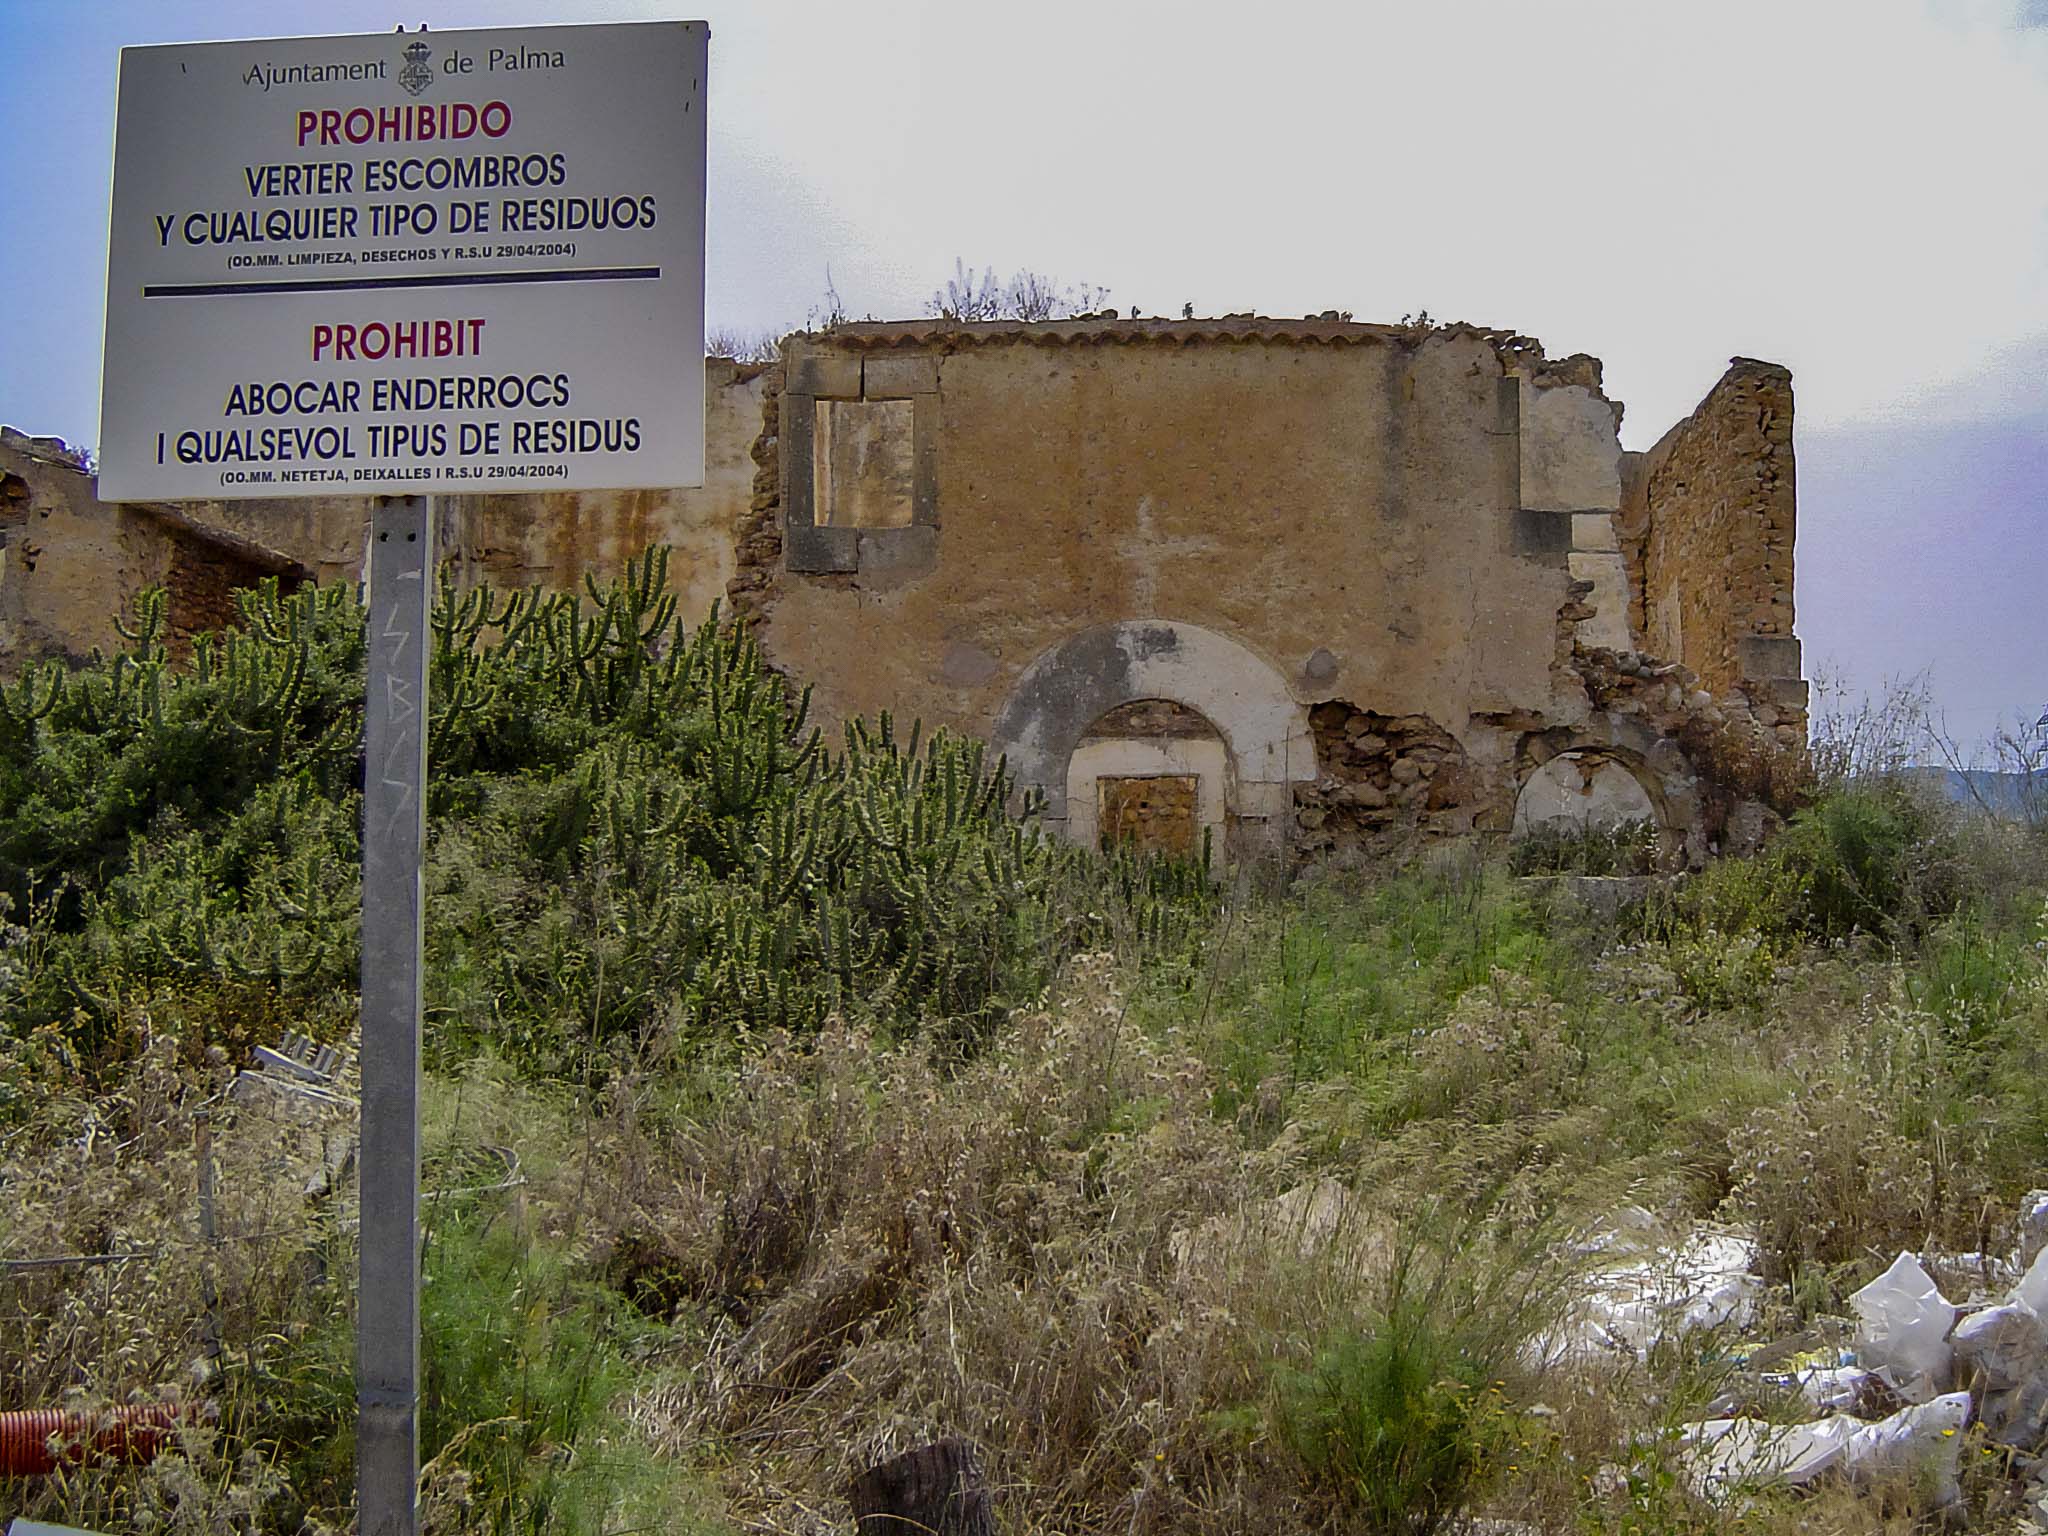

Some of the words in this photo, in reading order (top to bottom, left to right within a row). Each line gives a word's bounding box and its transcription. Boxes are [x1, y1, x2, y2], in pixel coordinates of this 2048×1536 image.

[249, 59, 387, 91] Ajuntament
[443, 49, 473, 74] de
[489, 45, 565, 71] Palma
[298, 101, 512, 147] PROHIBIDO
[246, 162, 354, 198] VERTER
[365, 153, 566, 193] ESCOMBROS
[156, 215, 174, 247] Y
[183, 207, 358, 245] CUALQUIER
[368, 203, 438, 237] TIPO
[449, 201, 490, 234] DE
[501, 195, 656, 233] RESIDUOS
[227, 255, 284, 270] (OO.MM.
[287, 252, 357, 267] LIMPIEZA,
[361, 249, 437, 263] DESECHOS
[441, 248, 451, 260] Y
[455, 246, 492, 260] R.S.U
[496, 243, 577, 258] 29/04/2004)
[313, 318, 486, 362] PROHIBIT
[225, 380, 361, 417] ABOCAR
[372, 373, 570, 412] ENDERROCS
[157, 432, 165, 465] I
[176, 426, 356, 464] QUALSEVOL
[367, 423, 447, 459] TIPUS
[459, 422, 500, 456] DE
[512, 418, 641, 455] RESIDUS
[220, 472, 277, 487] (OO.MM.
[281, 469, 349, 484] NETETJA,
[353, 467, 432, 482] DEIXALLES
[436, 467, 441, 480] I
[445, 466, 483, 480] R.S.U
[487, 465, 569, 479] 29/04/2004)
